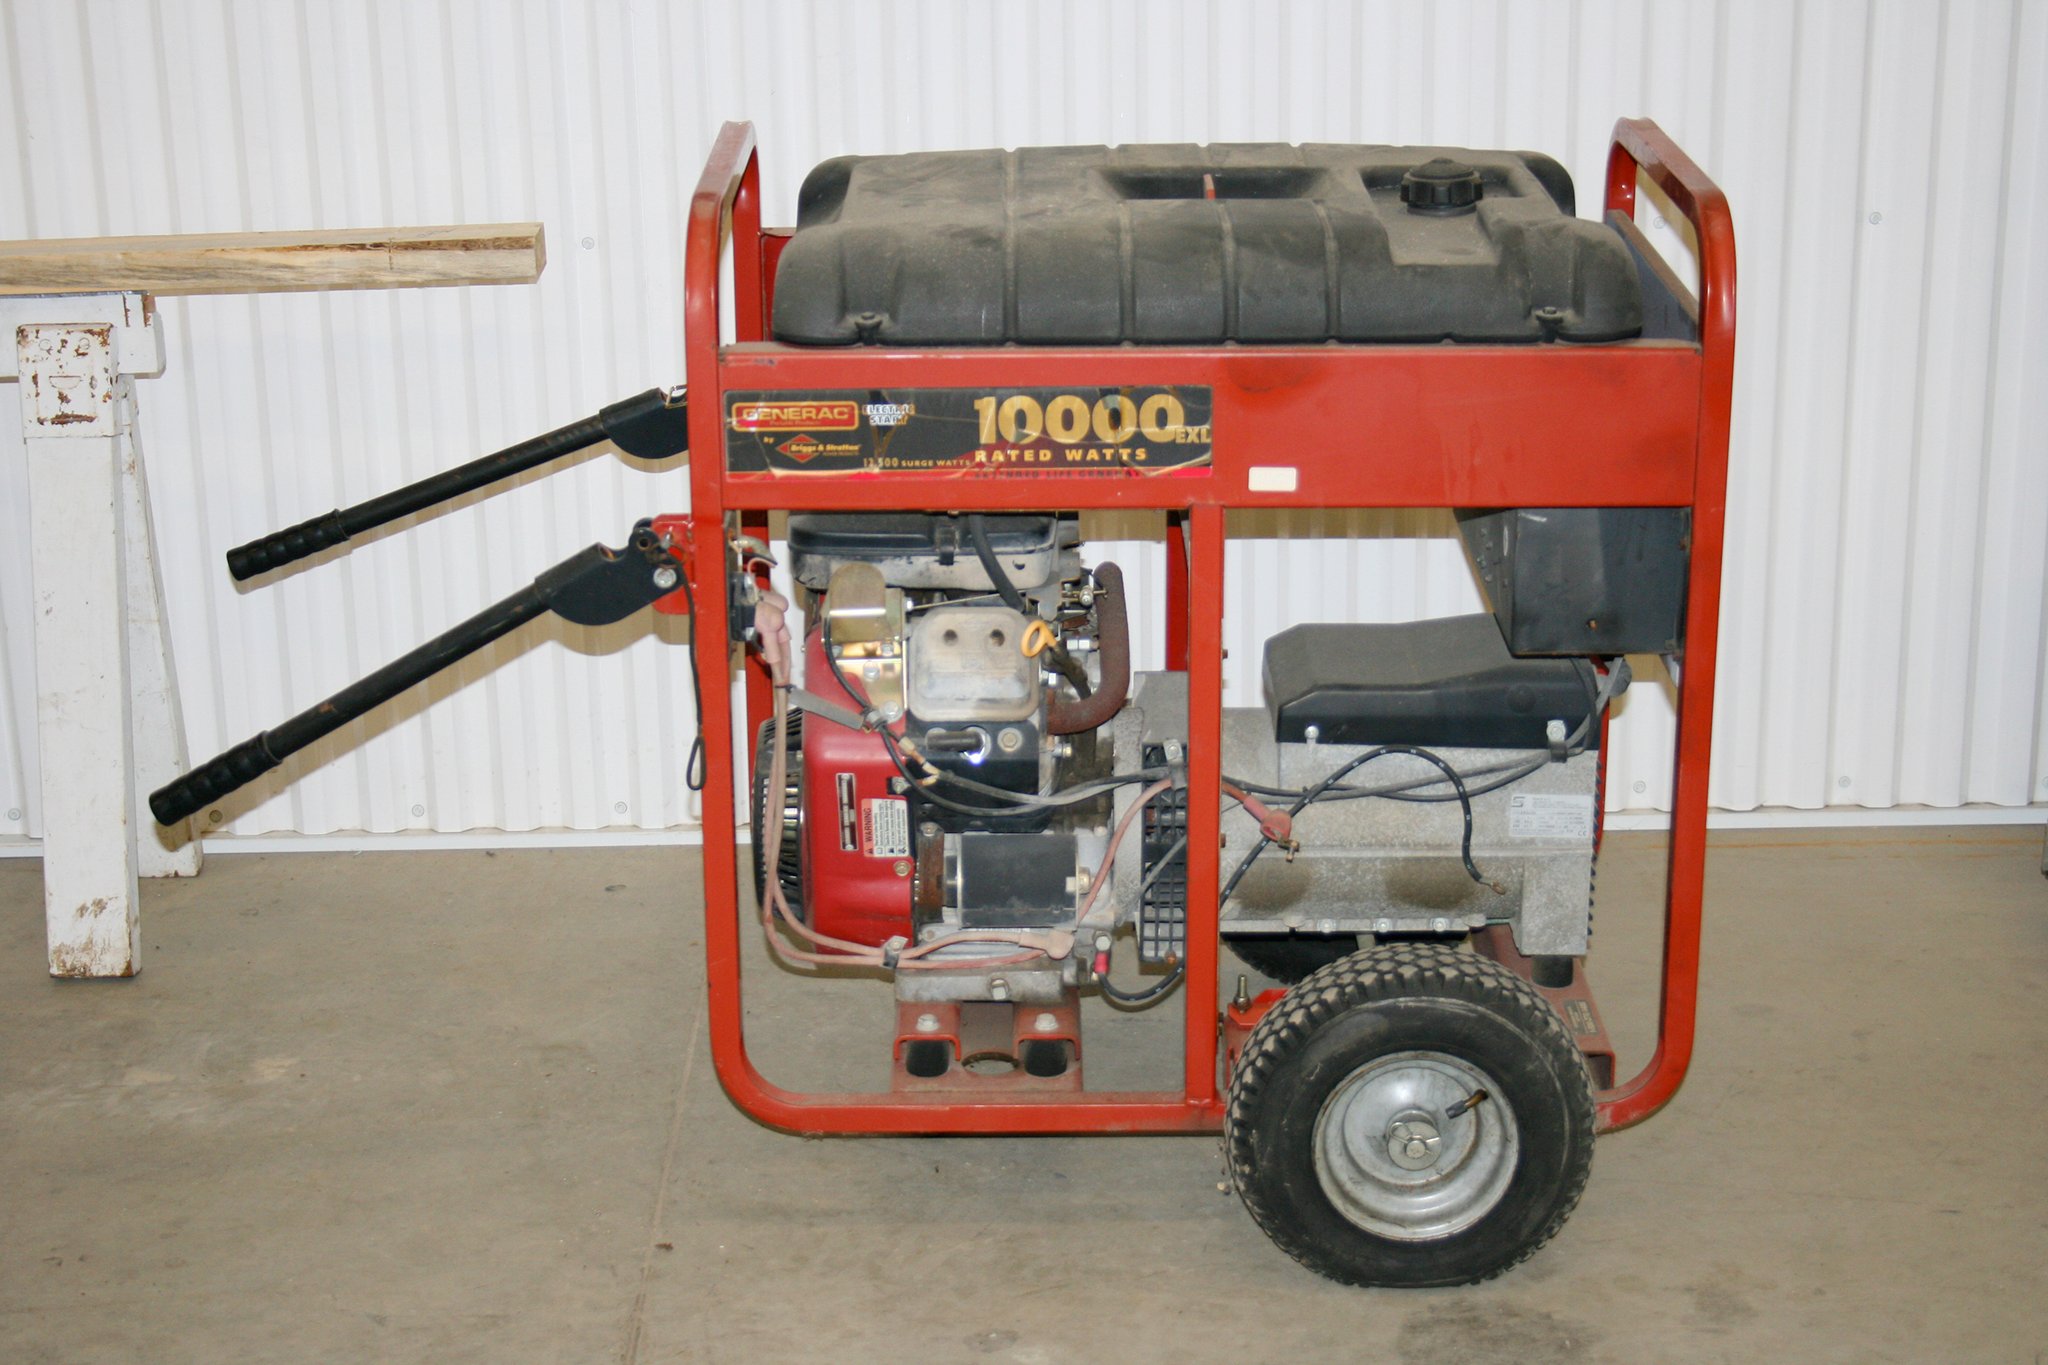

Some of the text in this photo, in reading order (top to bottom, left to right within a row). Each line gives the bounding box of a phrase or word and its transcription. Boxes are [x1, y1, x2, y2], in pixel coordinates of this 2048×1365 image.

[743, 407, 848, 420] GENERAC
[974, 394, 1210, 444] 10000 EXL
[790, 444, 816, 453] Briggs
[975, 448, 1146, 462] RATED WATTS
[901, 459, 933, 467] SURGE
[935, 459, 970, 467] WATTS
[863, 808, 873, 843] WARNING
